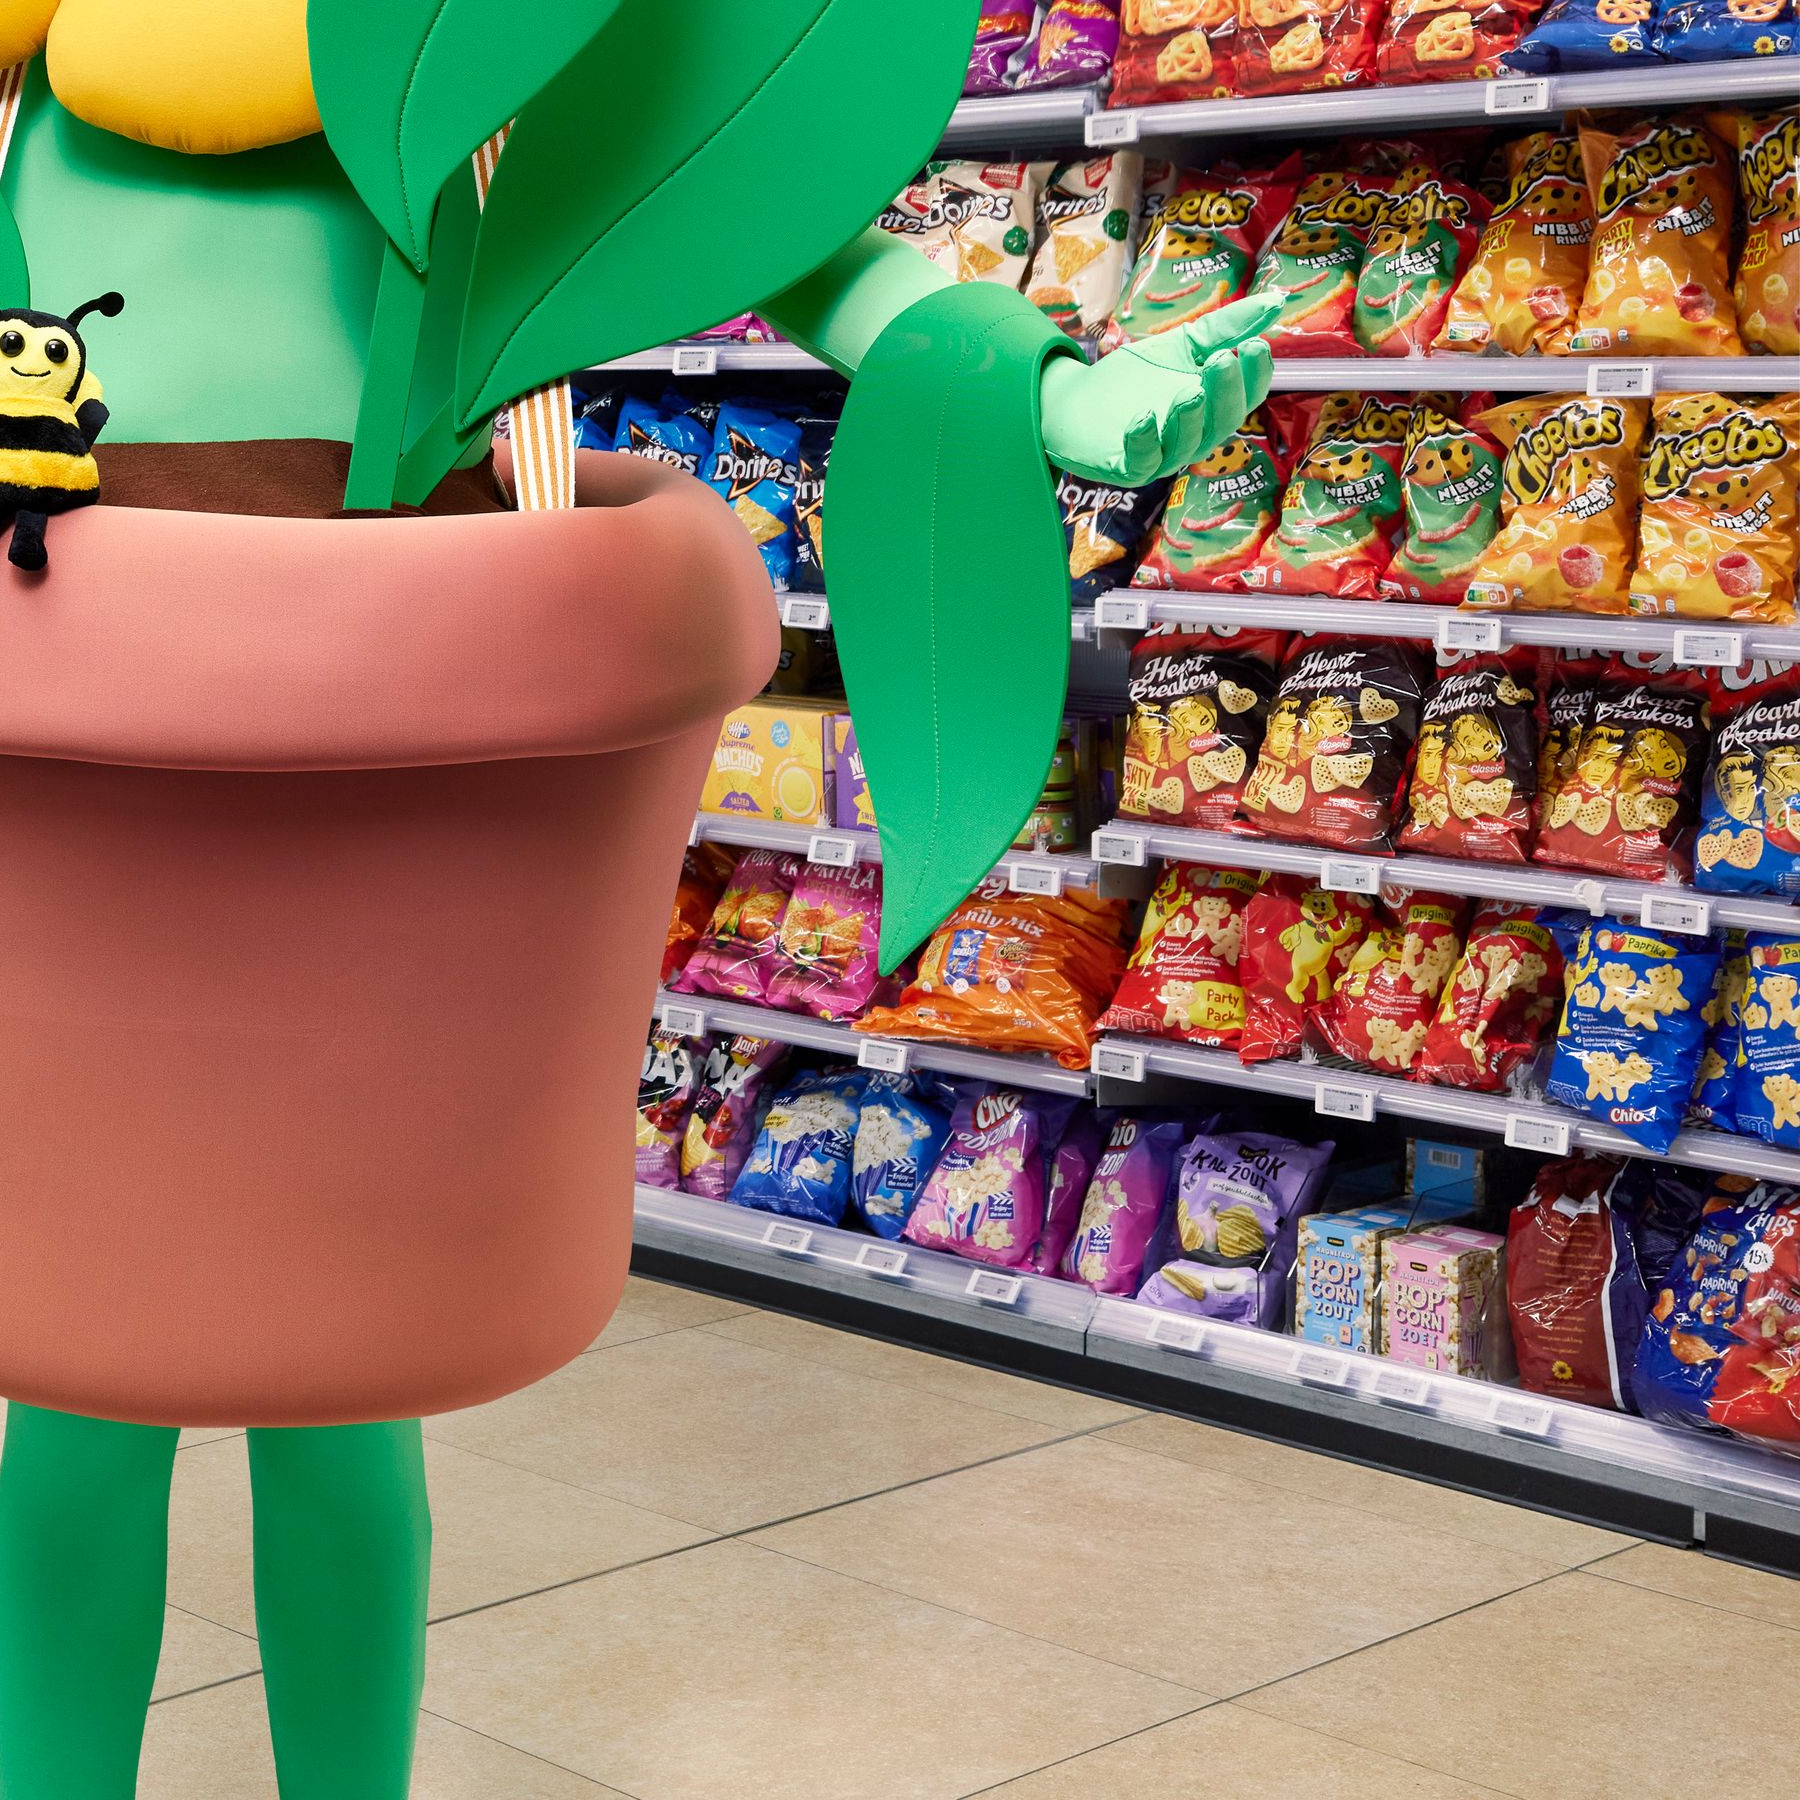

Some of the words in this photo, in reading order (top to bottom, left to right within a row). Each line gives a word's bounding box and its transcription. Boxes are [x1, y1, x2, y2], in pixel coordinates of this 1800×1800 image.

[1683, 216, 1716, 237] RINGS
[1556, 232, 1592, 245] RINGS
[1186, 262, 1230, 278] STICKS
[713, 452, 797, 484] Doritos
[1644, 411, 1789, 503] Cheetos
[1220, 480, 1265, 501] STICKS
[1337, 488, 1381, 506] STICKS
[1455, 479, 1495, 506] STICKS
[1146, 654, 1213, 684] Heart
[1302, 651, 1366, 677] Heart
[1128, 671, 1219, 700] Breakers
[1280, 669, 1363, 697] Breakers
[1441, 672, 1492, 697] Heart
[1424, 691, 1496, 721] Breakers
[1614, 686, 1694, 711] Heart
[1595, 702, 1694, 729] Breakers
[720, 735, 756, 751] Supreme
[1189, 736, 1220, 749] Classic
[714, 748, 764, 777] NACHOS
[1470, 764, 1503, 775] Classic
[1643, 778, 1678, 794] Classic
[1005, 915, 1046, 937] Mix
[1412, 907, 1454, 923] Original
[1505, 921, 1545, 943] Original
[1628, 938, 1667, 958] Paprika
[1207, 989, 1240, 1008] Party
[1207, 1007, 1235, 1022] Pack
[732, 1036, 760, 1059] Lay's
[975, 1090, 1022, 1130] Chio
[1610, 1107, 1644, 1124] Chio
[892, 1172, 911, 1182] Enjoy
[1228, 1162, 1267, 1191] ZOUT
[994, 1203, 1010, 1213] Enjoy
[1745, 1213, 1798, 1238] CHIPS
[1315, 1246, 1356, 1260] MAGNETRON
[1693, 1233, 1728, 1260] PAPRIKA
[1748, 1249, 1769, 1265] 15x
[1309, 1256, 1360, 1286] POP
[1399, 1272, 1440, 1286] MAGNETRON
[1309, 1283, 1359, 1307] CORN
[1700, 1277, 1738, 1295] PAPRIKA
[1394, 1283, 1442, 1312] POP
[1314, 1301, 1353, 1322] ZOUT
[1394, 1306, 1444, 1331] CORN
[1401, 1326, 1438, 1349] ZOET
